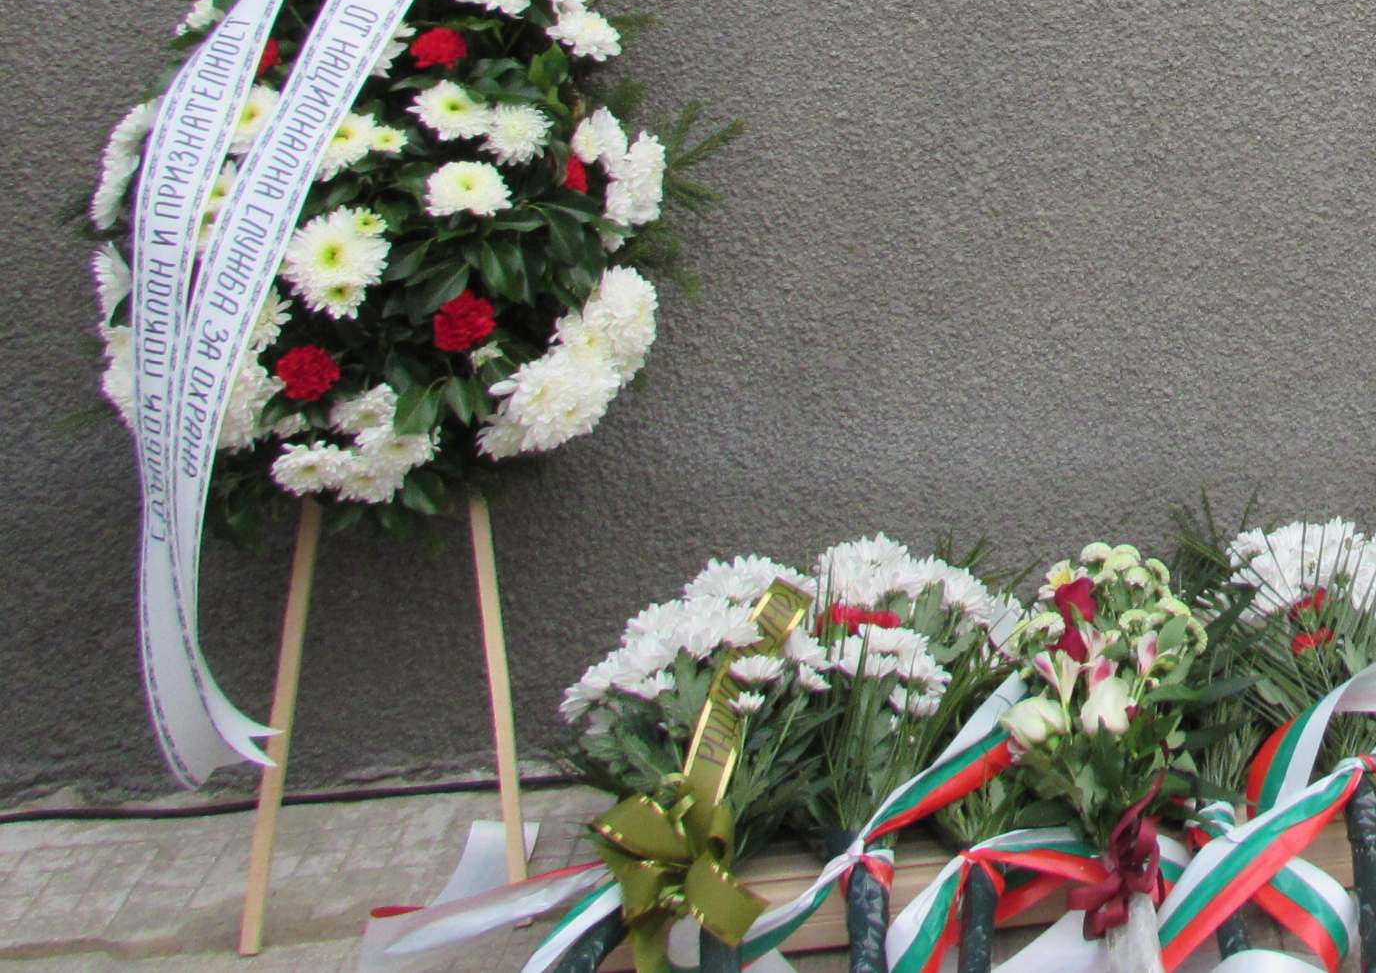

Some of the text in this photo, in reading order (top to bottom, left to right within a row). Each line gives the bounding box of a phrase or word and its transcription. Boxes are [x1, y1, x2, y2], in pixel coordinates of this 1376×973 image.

[154, 17, 251, 220] ПРИЗНАТЕЛНОСТ
[143, 258, 177, 379] ПОКЛОН
[151, 229, 179, 247] И
[182, 4, 380, 478] ОТ НАЦИОНАЛНА СЛУЖБА ЗА ОХРАНА
